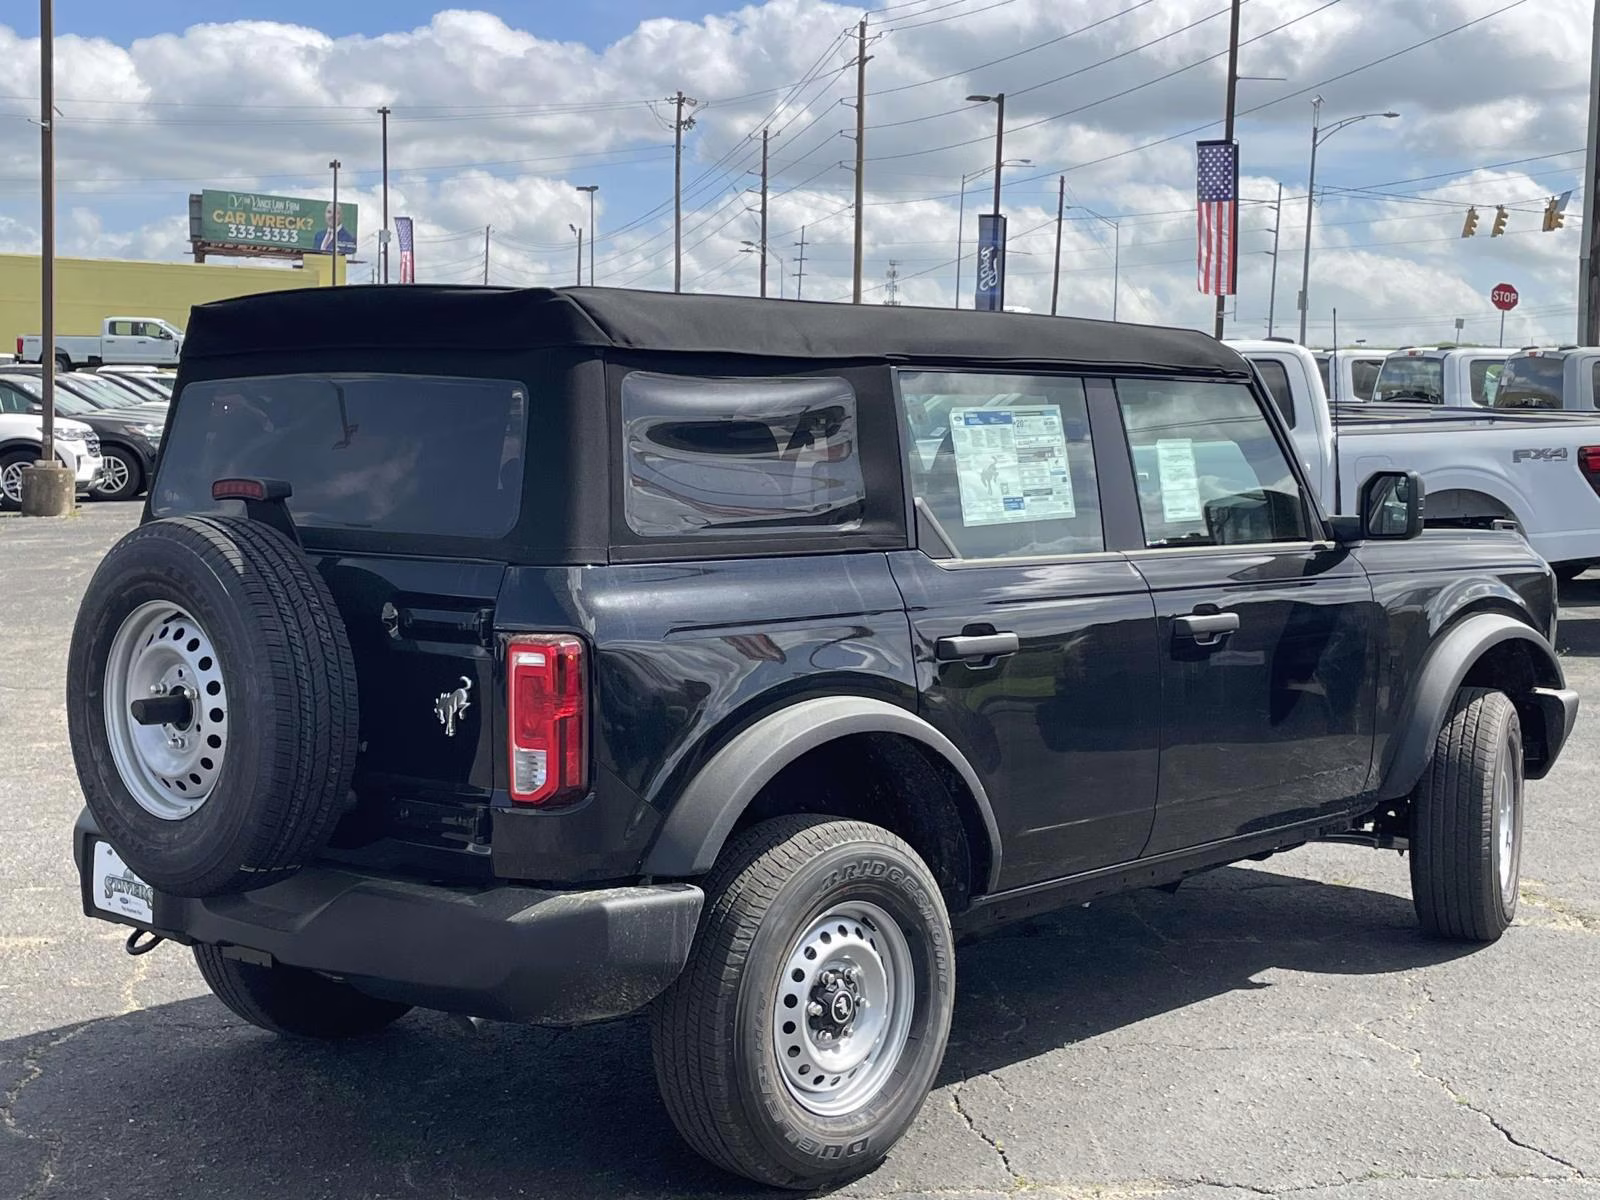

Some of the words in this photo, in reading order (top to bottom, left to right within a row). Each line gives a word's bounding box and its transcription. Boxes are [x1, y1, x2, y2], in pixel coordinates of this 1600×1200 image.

[250, 195, 271, 209] VANCE
[212, 210, 246, 225] CAR
[250, 213, 314, 231] WRECK?
[228, 223, 299, 243] 333-3333
[1492, 290, 1518, 303] STOP
[1512, 447, 1568, 463] FX4
[821, 859, 950, 996] BRIDGESTONE
[757, 1063, 871, 1160] DUELER
